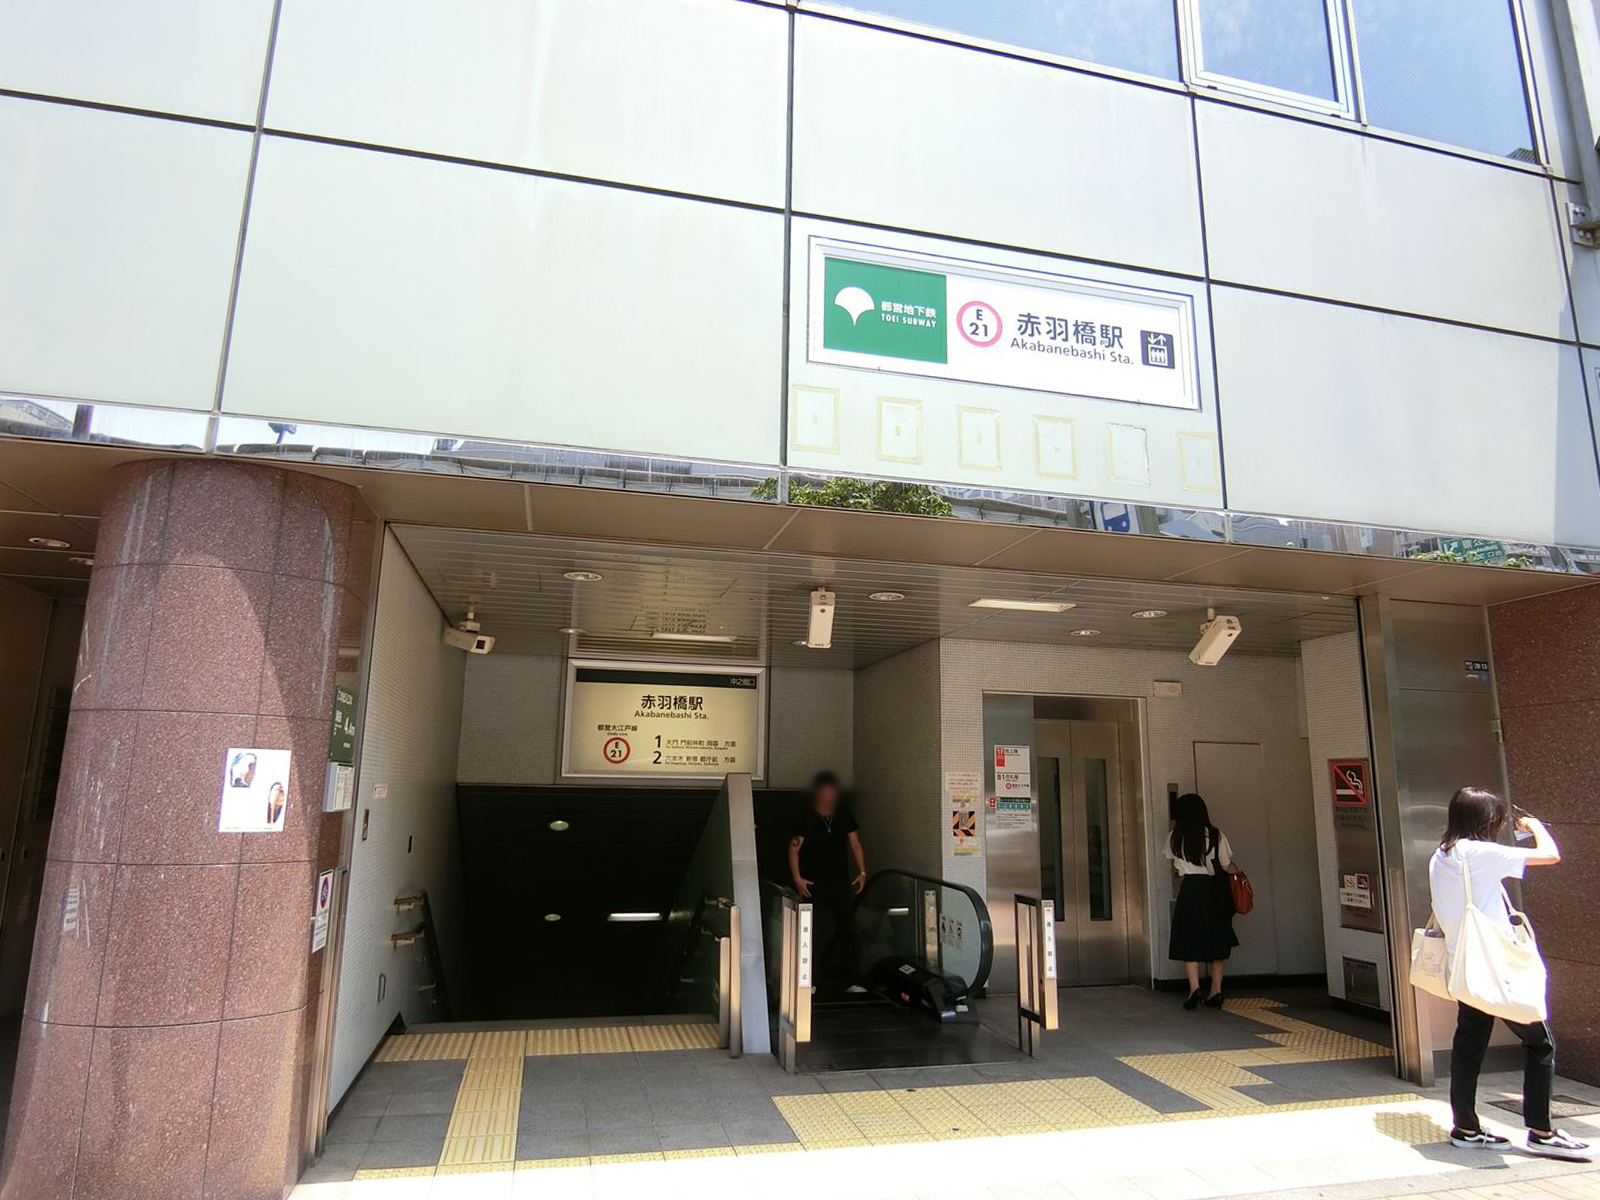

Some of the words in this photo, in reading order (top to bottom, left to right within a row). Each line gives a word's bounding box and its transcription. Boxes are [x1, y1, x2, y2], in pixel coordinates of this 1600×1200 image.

[881, 301, 936, 318] 都営地下鉄
[976, 309, 983, 321] E
[881, 313, 899, 323] TOEI
[902, 316, 936, 328] SUBWAY
[969, 322, 988, 337] 21
[1017, 312, 1124, 349] 赤羽橋駅
[1010, 337, 1106, 361] Akabanebashi
[1110, 351, 1134, 365] Sta.
[641, 694, 703, 711] 赤羽橋駅
[634, 710, 692, 719] Akabanebashi
[694, 711, 710, 720] Sta.
[614, 741, 620, 749] E
[654, 735, 661, 748] 1
[610, 749, 622, 758] 21
[652, 751, 662, 765] 2
